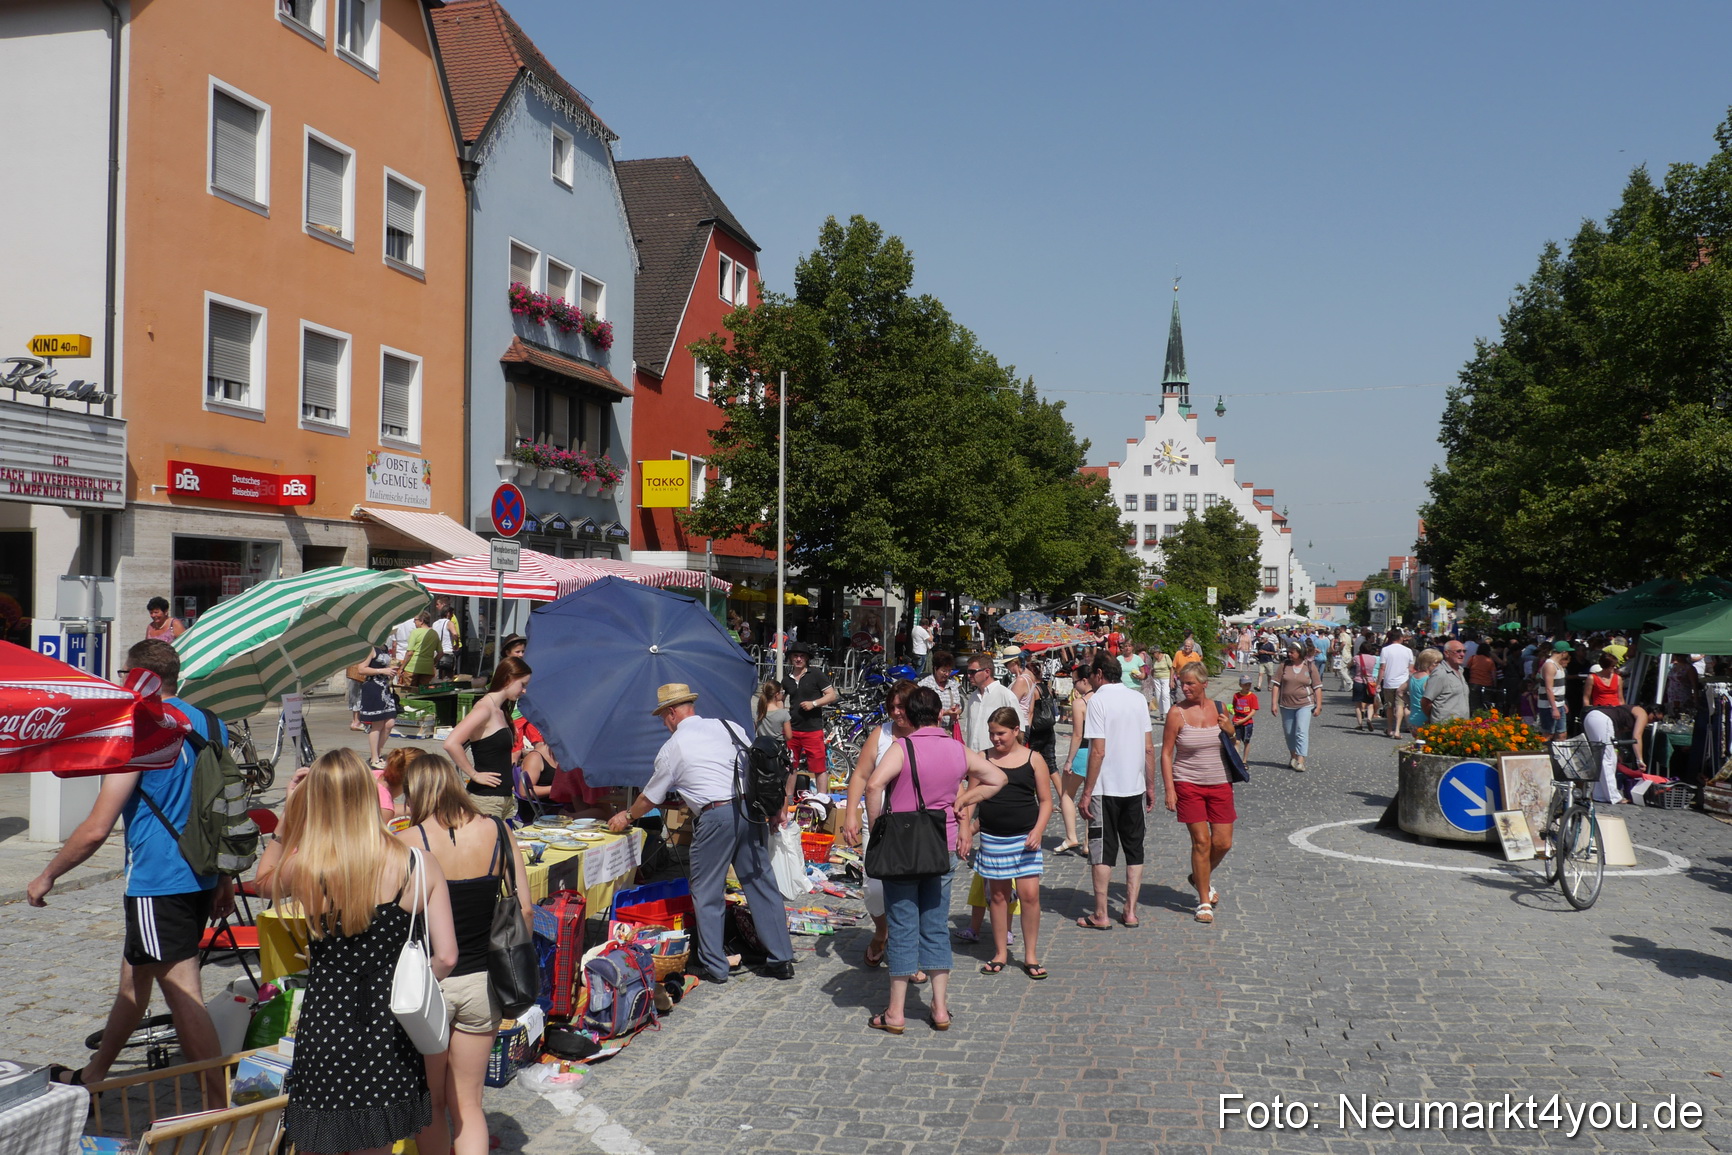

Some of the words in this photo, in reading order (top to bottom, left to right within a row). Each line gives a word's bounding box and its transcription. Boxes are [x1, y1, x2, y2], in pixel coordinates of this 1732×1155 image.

[32, 338, 58, 352] KINO
[53, 454, 69, 467] ICH
[386, 457, 409, 472] OBST
[411, 462, 418, 473] &
[0, 467, 25, 481] FACH
[31, 471, 113, 491] UNVERBESSERLICH
[116, 481, 122, 491] 2
[175, 471, 200, 491] DER
[232, 474, 260, 486] Deutsches
[381, 473, 418, 489] GEMÜSE
[9, 481, 71, 499] DAMPFNUDEL
[75, 488, 104, 501] BLUES
[232, 487, 260, 498] Reisebüro
[283, 481, 307, 496] DER
[369, 489, 404, 502] Italienische
[71, 637, 99, 649] HIR
